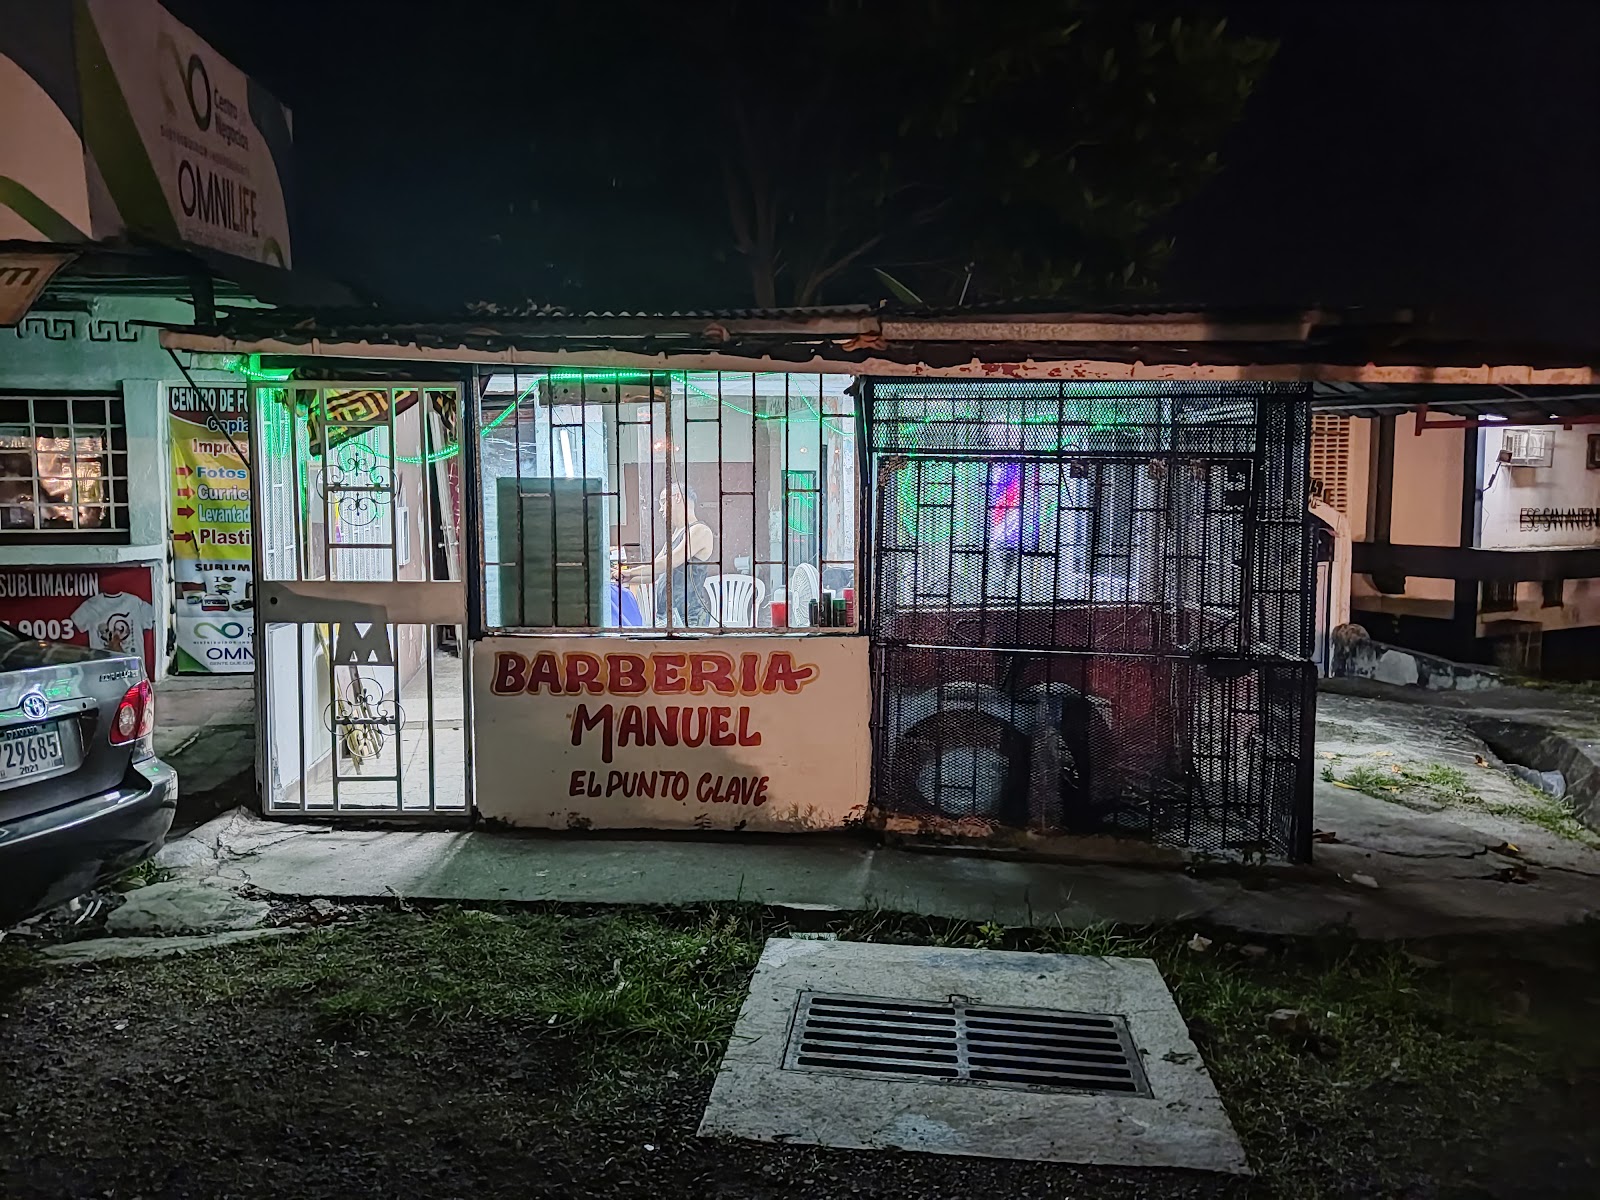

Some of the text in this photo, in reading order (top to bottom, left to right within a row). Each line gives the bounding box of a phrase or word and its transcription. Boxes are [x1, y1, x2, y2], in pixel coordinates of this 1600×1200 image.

[178, 160, 259, 238] OMNILIFE
[171, 388, 216, 412] CENTRO
[219, 389, 235, 412] DE
[197, 466, 246, 478] Fotos
[0, 572, 98, 597] SUBLIMACION
[492, 651, 819, 696] BARBERIA
[571, 703, 762, 763] MANUEL
[19, 764, 39, 775] 2021
[569, 770, 770, 807] EL PUNTO CLAVE
